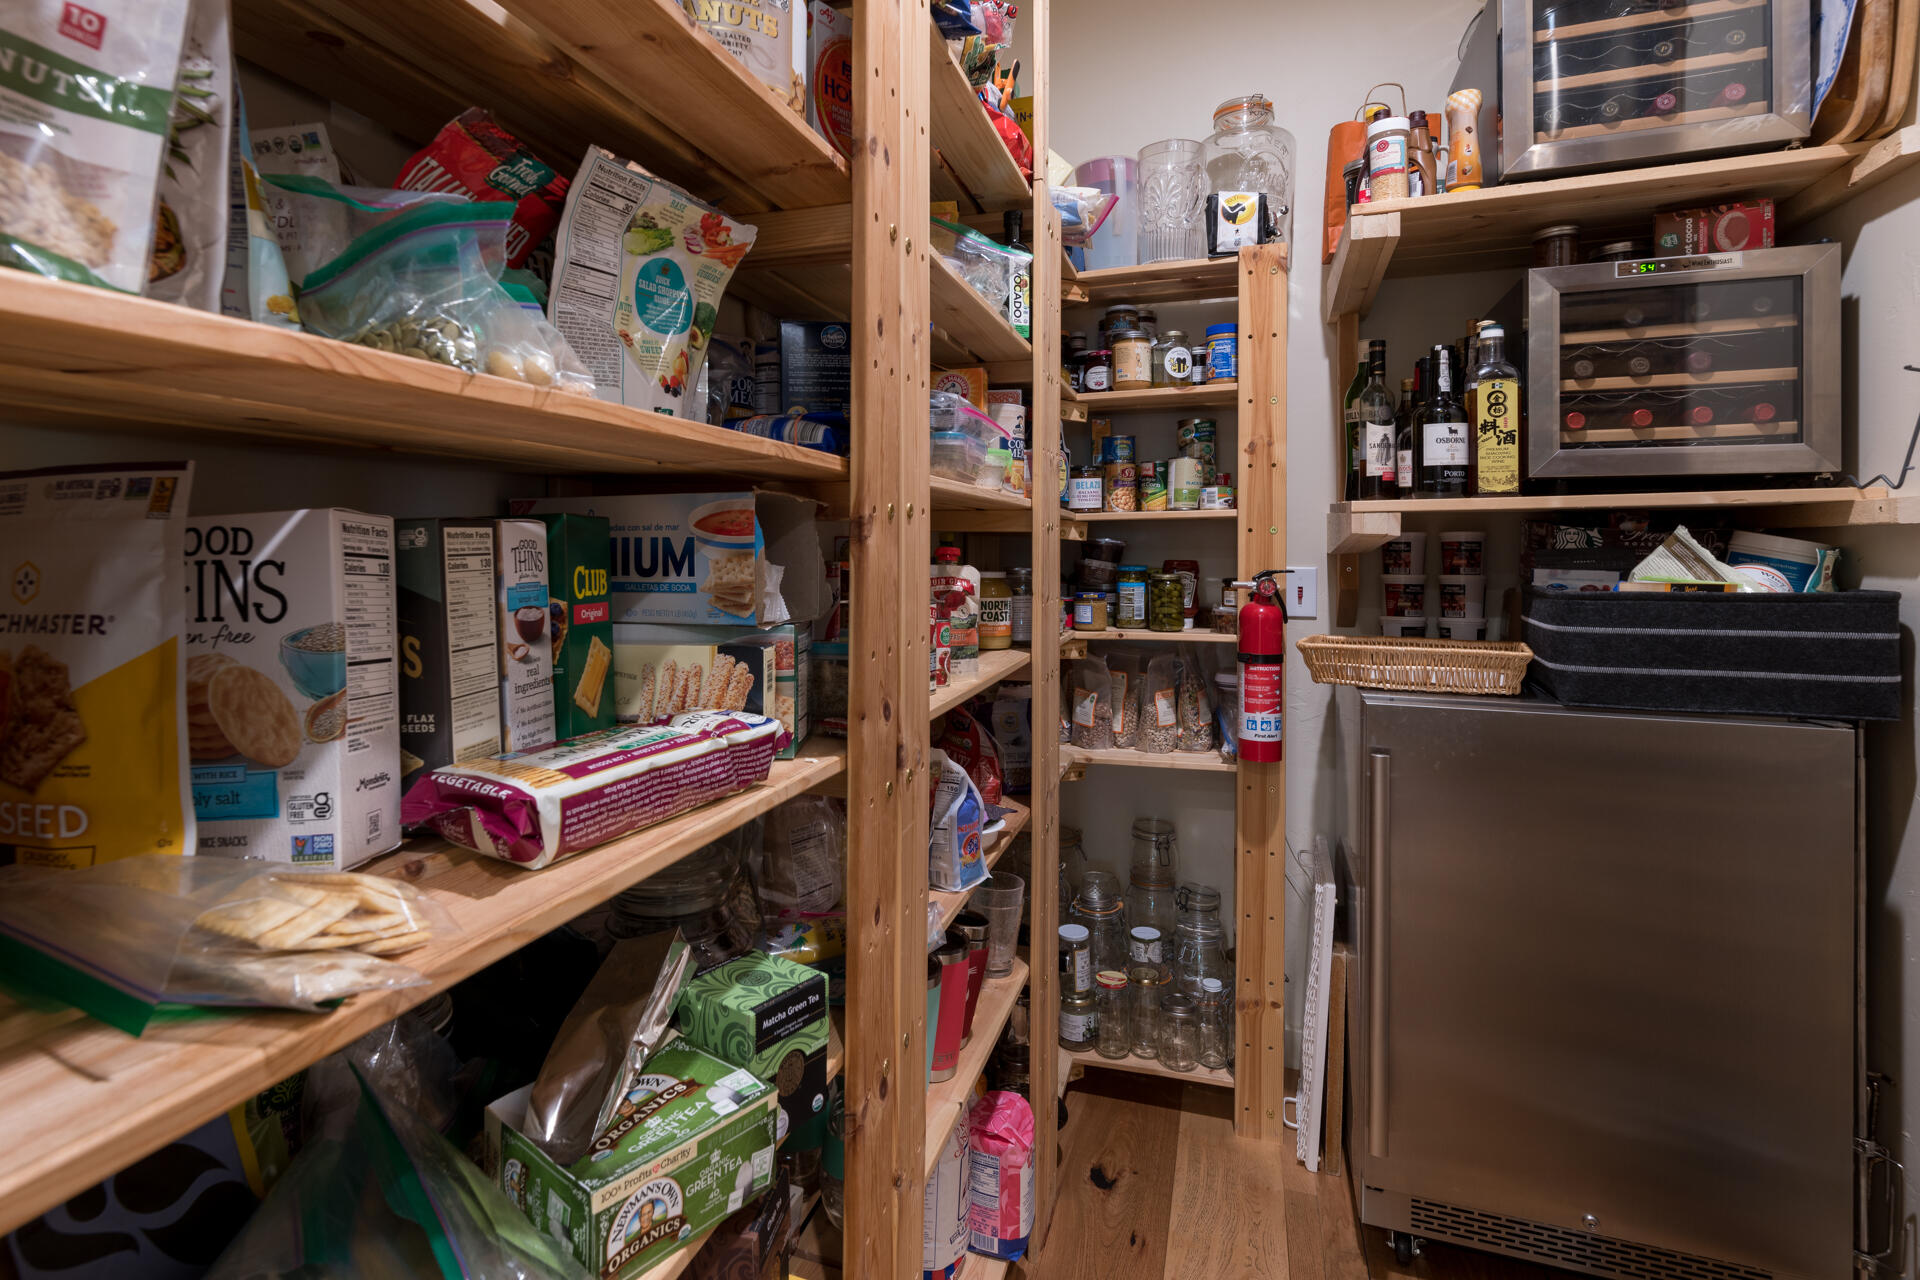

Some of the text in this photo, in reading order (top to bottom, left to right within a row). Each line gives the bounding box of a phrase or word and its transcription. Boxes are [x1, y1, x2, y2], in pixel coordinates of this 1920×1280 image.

[67, 6, 99, 33] 10
[598, 164, 646, 191] Nutrition Facts
[1640, 264, 1656, 273] 54
[519, 539, 538, 550] GOOD
[511, 546, 544, 573] THINS
[184, 559, 289, 625] INS
[574, 565, 608, 600] CLUB
[624, 583, 691, 592] GALLETAS DE SODA
[581, 607, 603, 621] Original
[980, 600, 1009, 611] NORTH
[980, 611, 1009, 622] COAST
[210, 624, 256, 649] free
[526, 663, 540, 677] real
[515, 676, 551, 695] ingredients
[401, 724, 436, 733] SEEDS
[407, 714, 435, 723] FLAX
[215, 789, 241, 805] salt
[430, 774, 513, 800] VEGETABLE
[289, 802, 314, 810] GLUTEN
[290, 811, 304, 819] FREE
[0, 802, 89, 839] SEED
[762, 1012, 786, 1030] Matcha
[786, 1000, 807, 1017] Green
[807, 993, 820, 1006] Tea
[595, 1081, 688, 1151] ORGANICS
[676, 1101, 708, 1127] TEA
[623, 1169, 653, 1192] Profits
[661, 1146, 691, 1169] Charity
[685, 1154, 743, 1198] GREEN TEA
[700, 1154, 731, 1177] ORGANIC
[611, 1181, 679, 1244] NEWMAN'S OWN
[607, 1217, 681, 1274] ORGANICS
